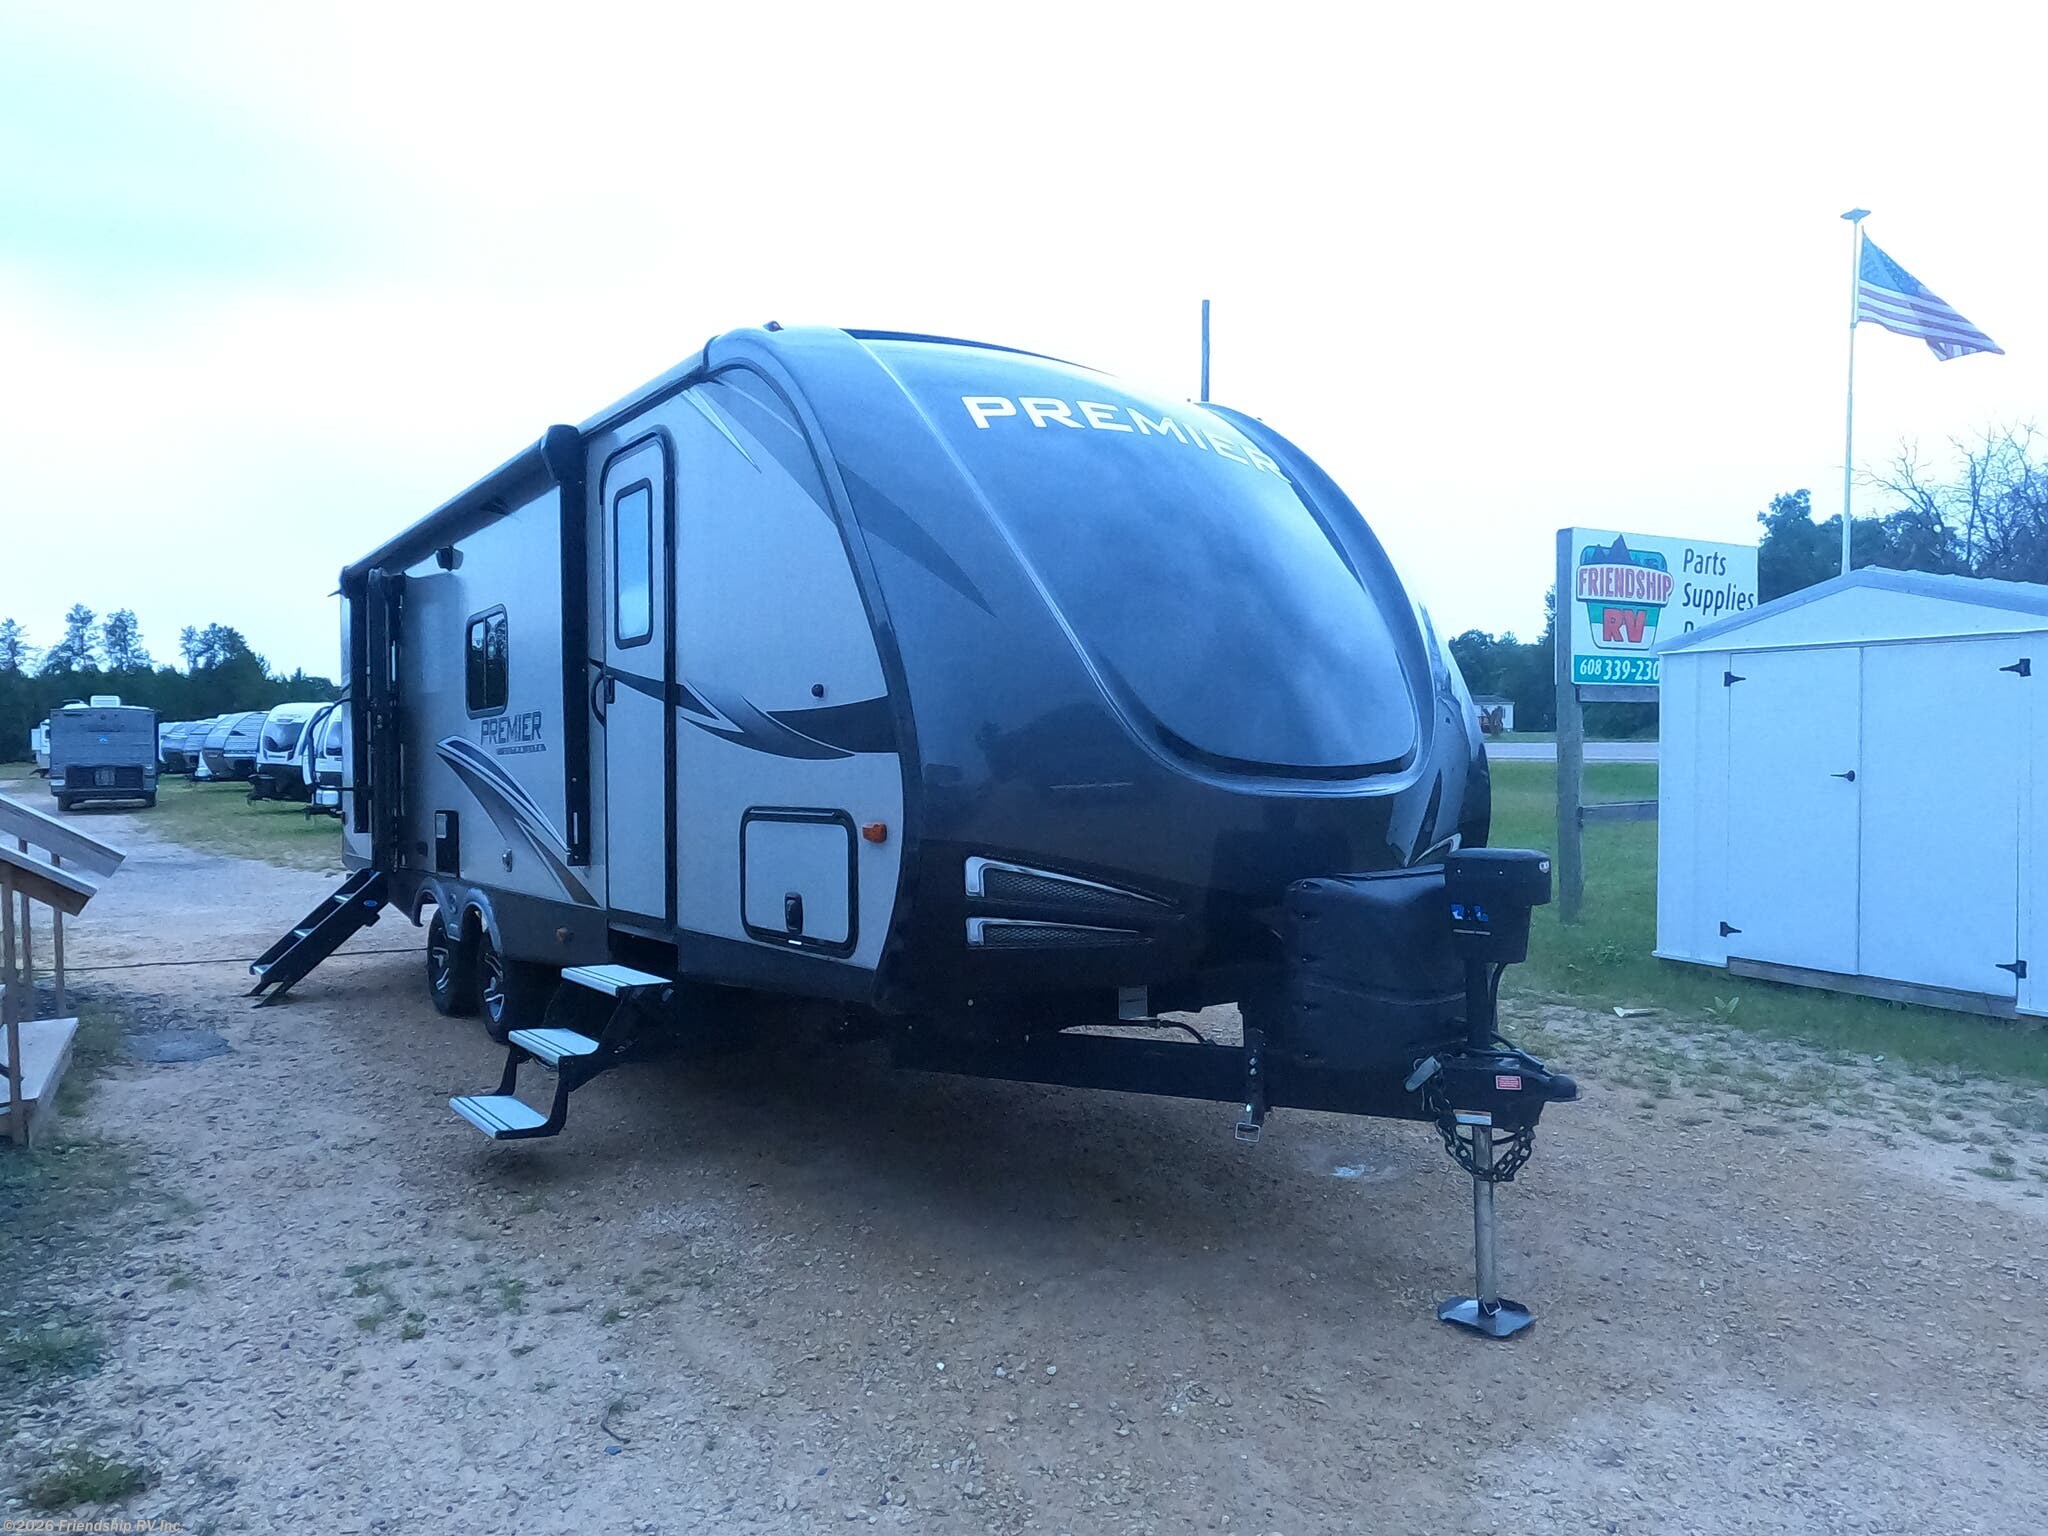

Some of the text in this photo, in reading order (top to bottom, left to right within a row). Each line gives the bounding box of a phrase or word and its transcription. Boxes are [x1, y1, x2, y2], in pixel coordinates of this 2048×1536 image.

[961, 396, 1292, 484] PREMIER
[1682, 548, 1727, 576] Parts
[1578, 566, 1672, 601] FRIENDSHIP
[1682, 582, 1755, 616] Supplies
[1602, 607, 1648, 643] RV
[1579, 658, 1660, 681] 608 339-230
[480, 710, 542, 746] PREMIER
